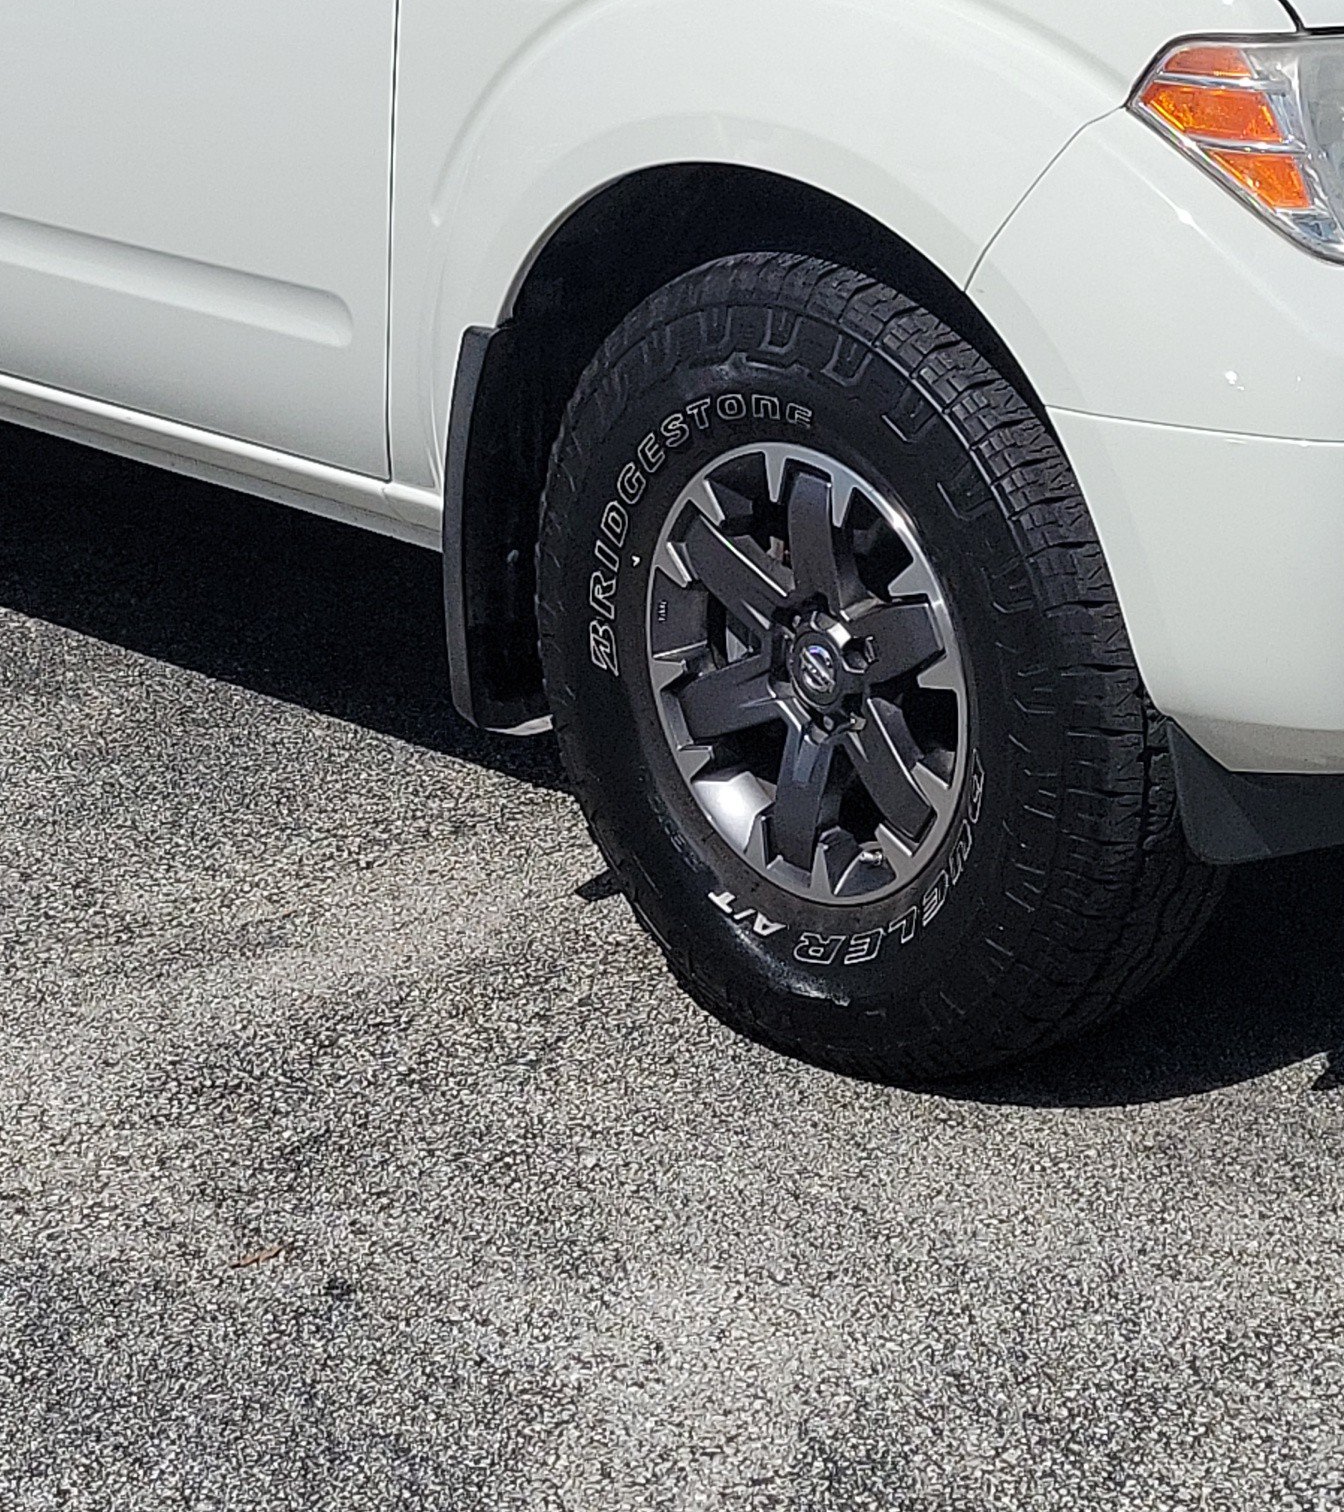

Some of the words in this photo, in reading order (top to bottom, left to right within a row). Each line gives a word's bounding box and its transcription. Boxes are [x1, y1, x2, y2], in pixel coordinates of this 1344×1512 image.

[589, 393, 812, 677] BRIDGESTONE
[708, 891, 789, 937] A/T
[793, 747, 985, 965] DUELER
